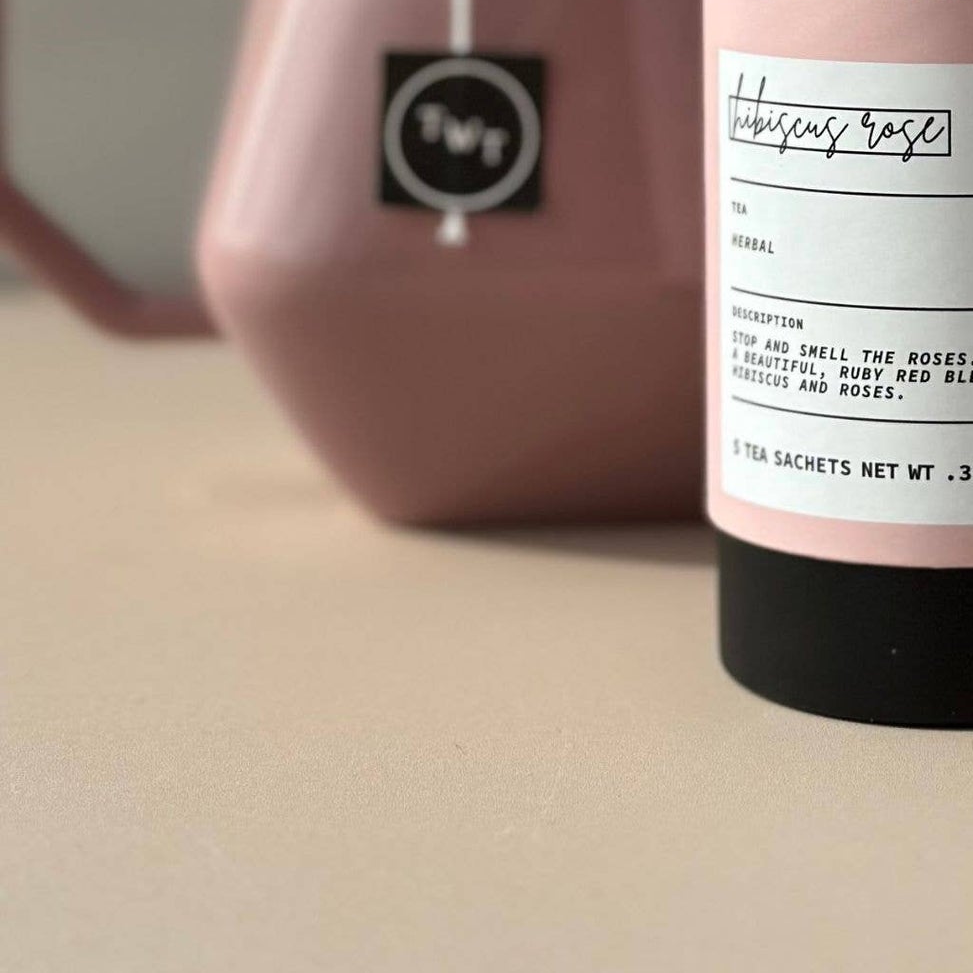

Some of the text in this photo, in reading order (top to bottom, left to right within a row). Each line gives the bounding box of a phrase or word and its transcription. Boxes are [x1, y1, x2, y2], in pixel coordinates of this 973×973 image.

[731, 73, 946, 163] hibiscus rose
[732, 201, 747, 216] TEA
[732, 234, 774, 255] HERBAL
[732, 306, 803, 330] DESCRIPTION
[733, 331, 757, 347] STOP
[765, 338, 790, 354] AND
[800, 345, 848, 361] SMELL
[862, 350, 895, 364] THE
[733, 366, 905, 400] HIBISCUS AND ROSES.
[744, 352, 825, 379] BEAUTIFUL,
[840, 367, 884, 381] RUBY
[896, 370, 931, 383] RED
[744, 443, 768, 463] TEA
[774, 451, 851, 475] SACHETS
[861, 463, 897, 479] NET
[908, 465, 934, 481] WT
